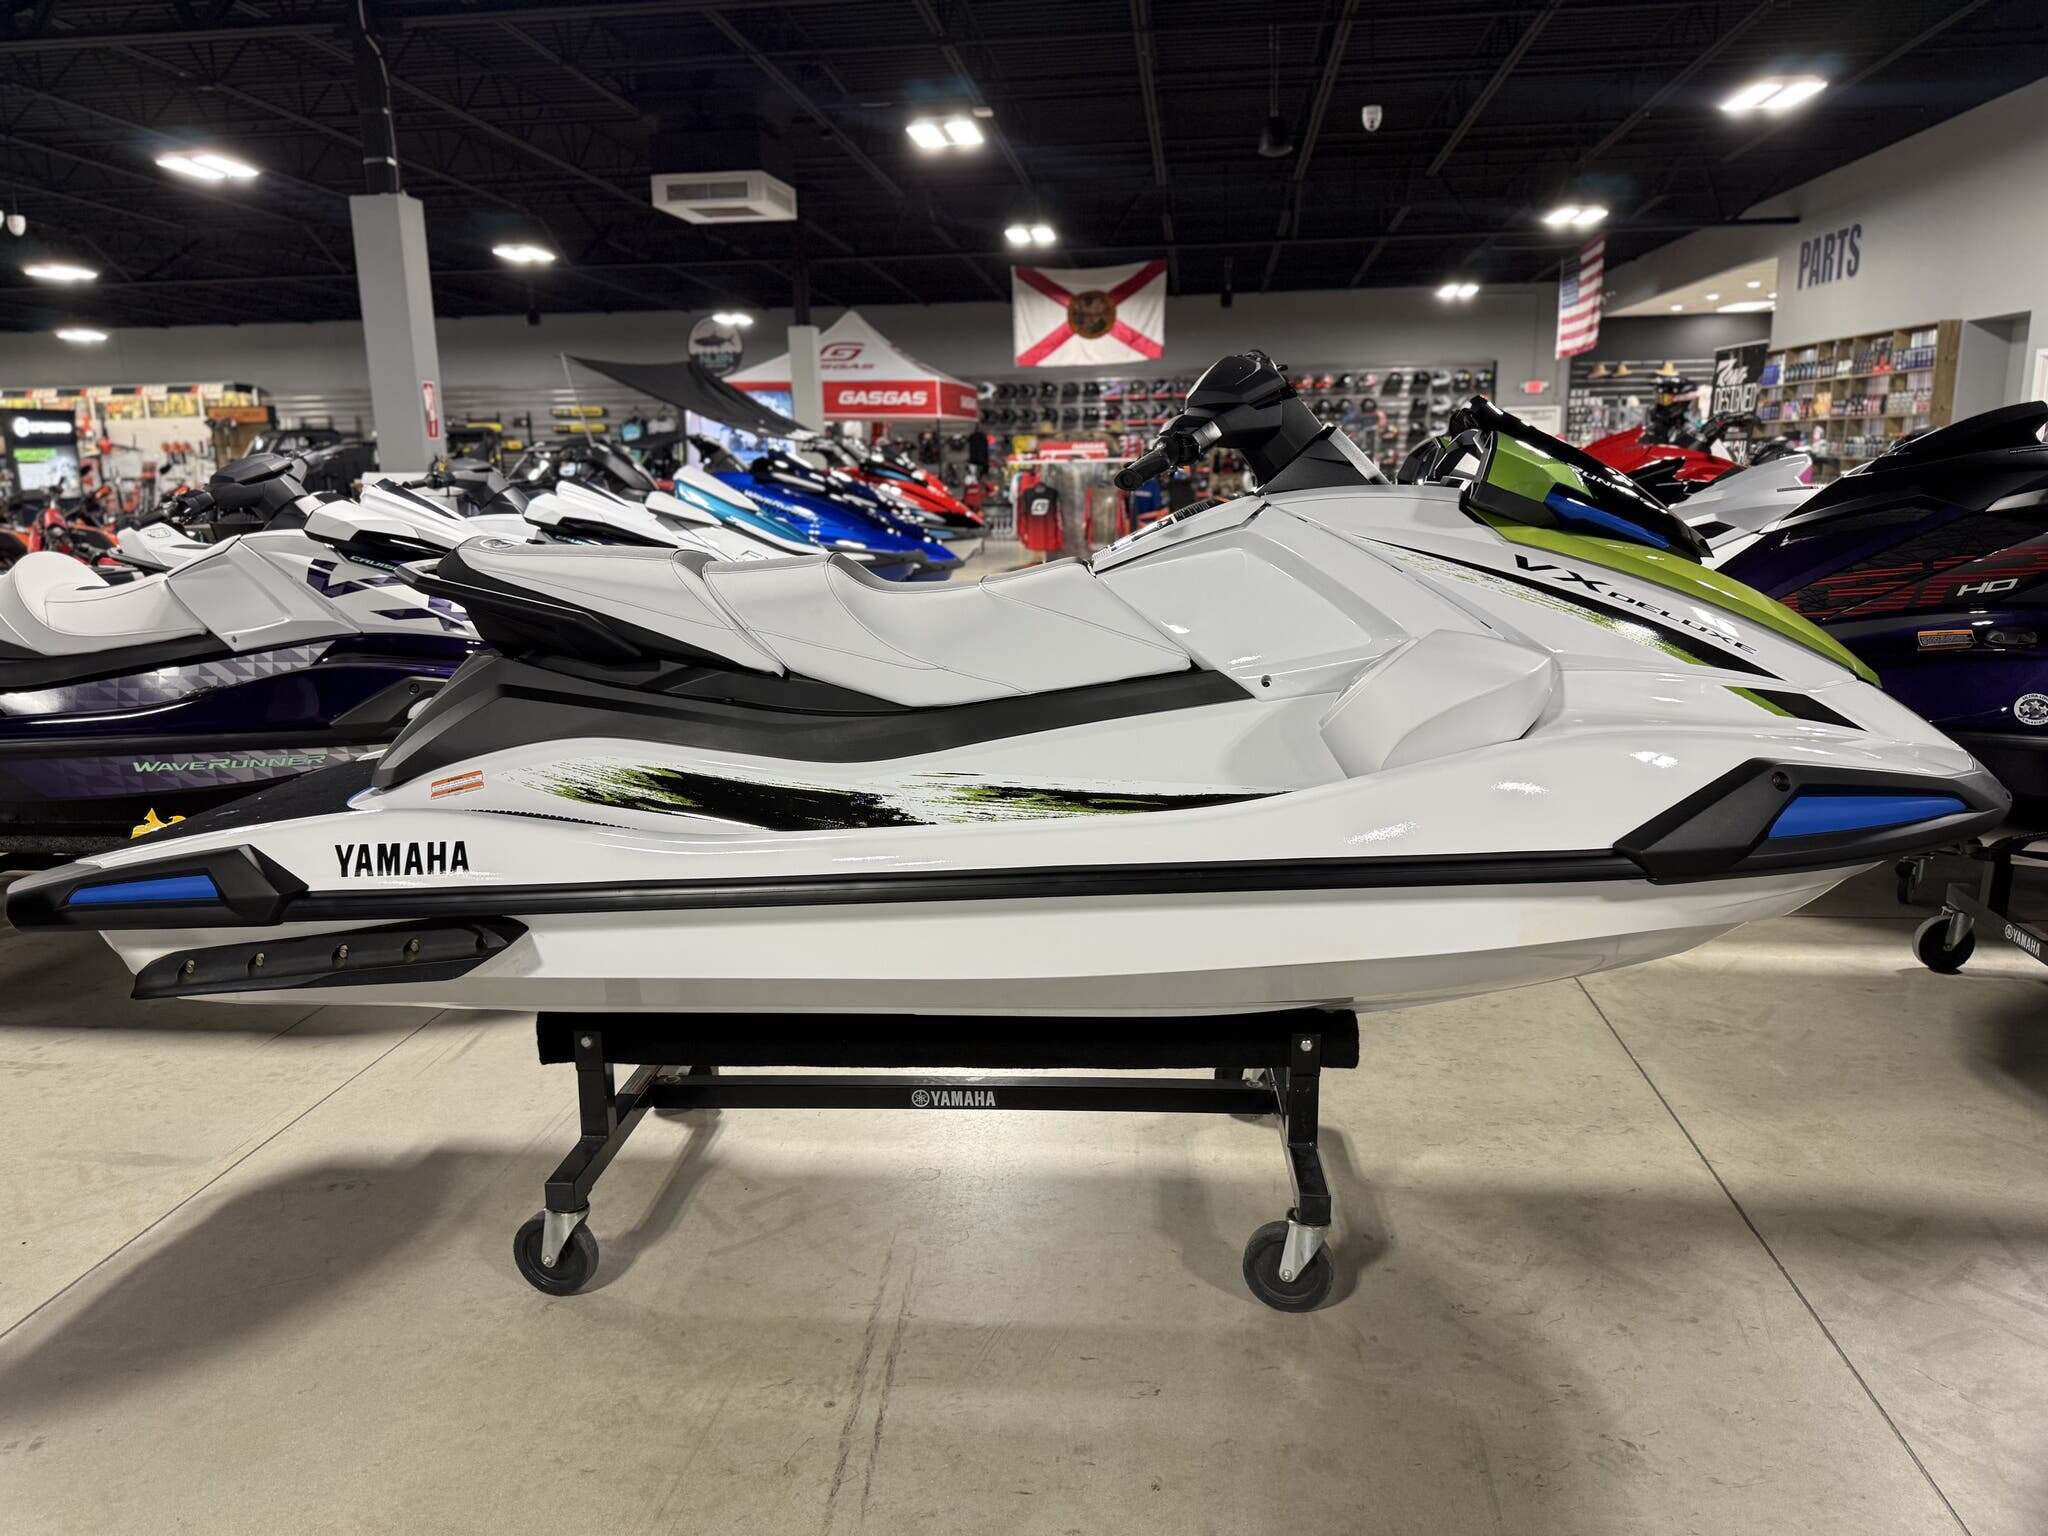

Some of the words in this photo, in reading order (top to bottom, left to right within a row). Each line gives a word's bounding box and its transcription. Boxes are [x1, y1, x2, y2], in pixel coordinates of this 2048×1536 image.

[1797, 223, 1862, 291] PARTS
[838, 390, 928, 407] GASGAS
[1514, 554, 1612, 594] VX
[1607, 591, 1757, 655] DELUXE
[132, 753, 326, 773] WAVERUNNER
[334, 840, 470, 878] YAMAHA
[2012, 928, 2041, 957] YAMAHA
[930, 1090, 996, 1107] YAMAHA
